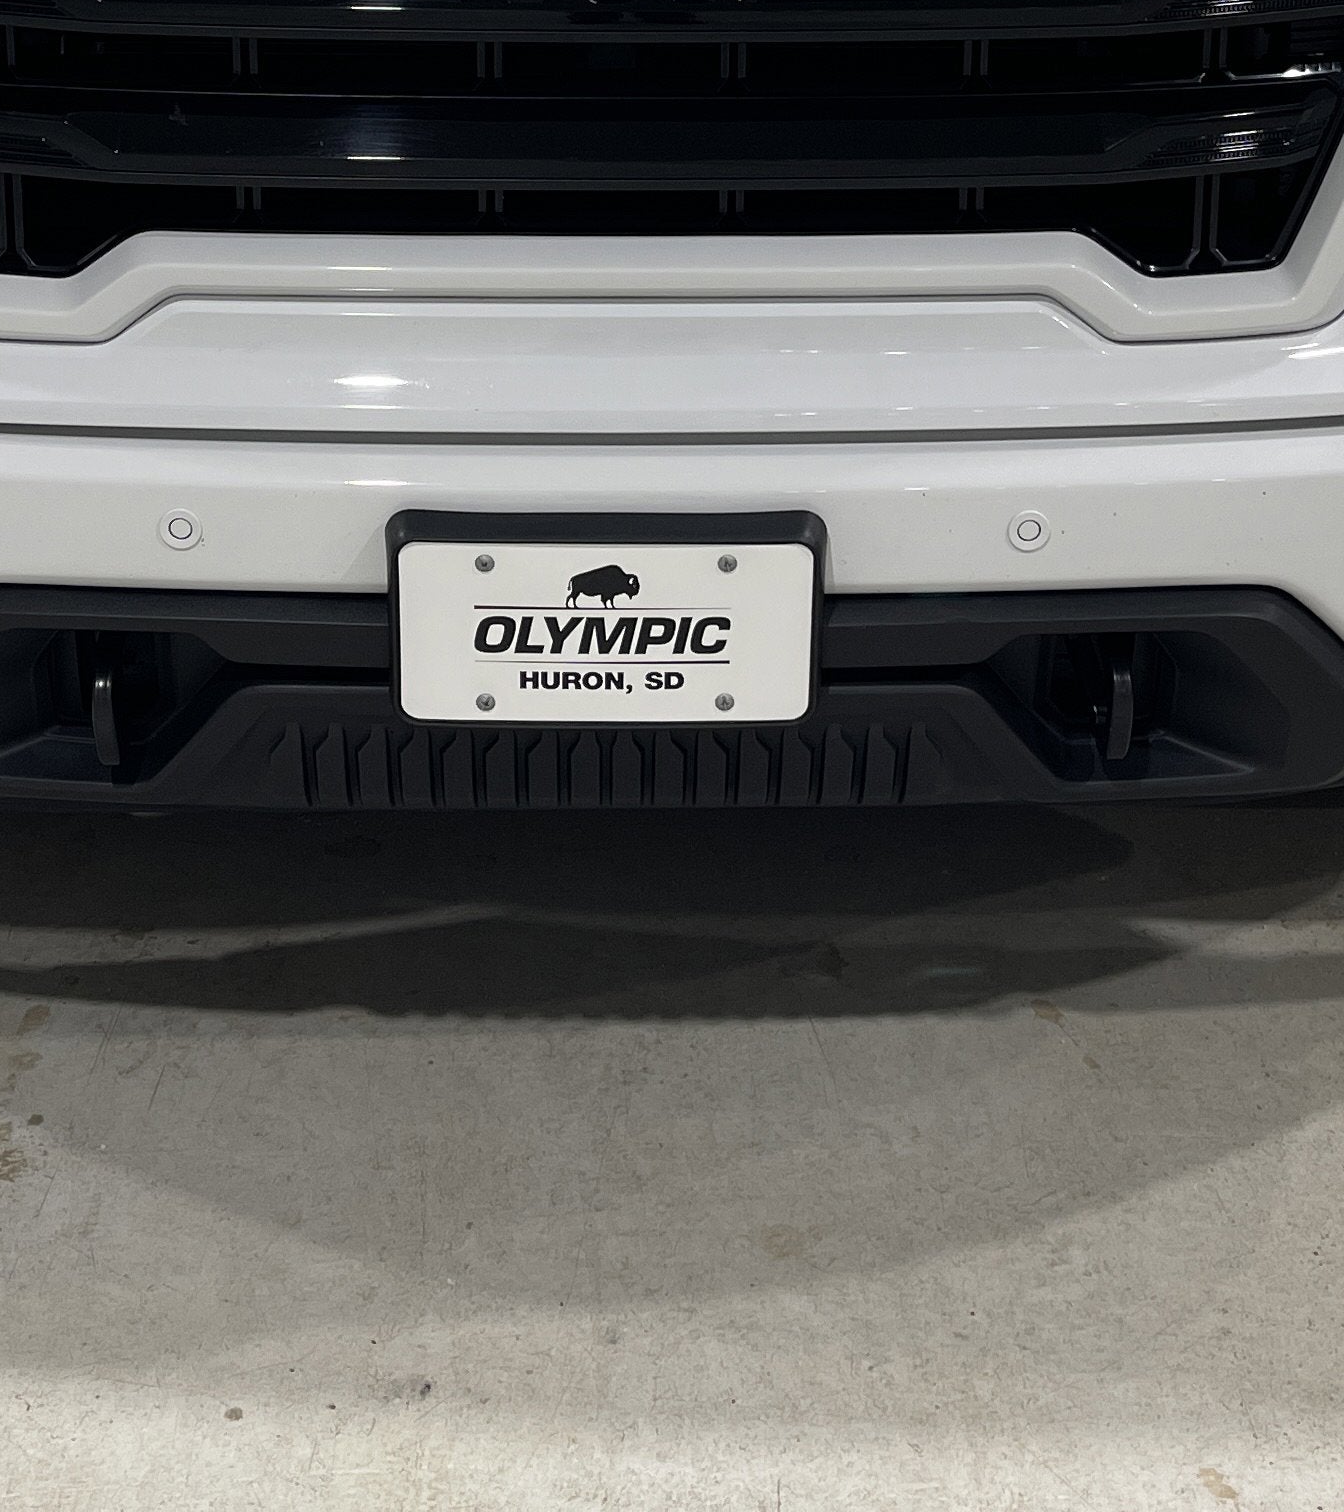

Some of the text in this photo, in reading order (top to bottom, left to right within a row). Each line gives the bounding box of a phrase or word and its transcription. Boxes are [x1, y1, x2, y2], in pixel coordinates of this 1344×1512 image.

[474, 615, 731, 655] OLYMPIC
[519, 670, 685, 695] HURON, SD
